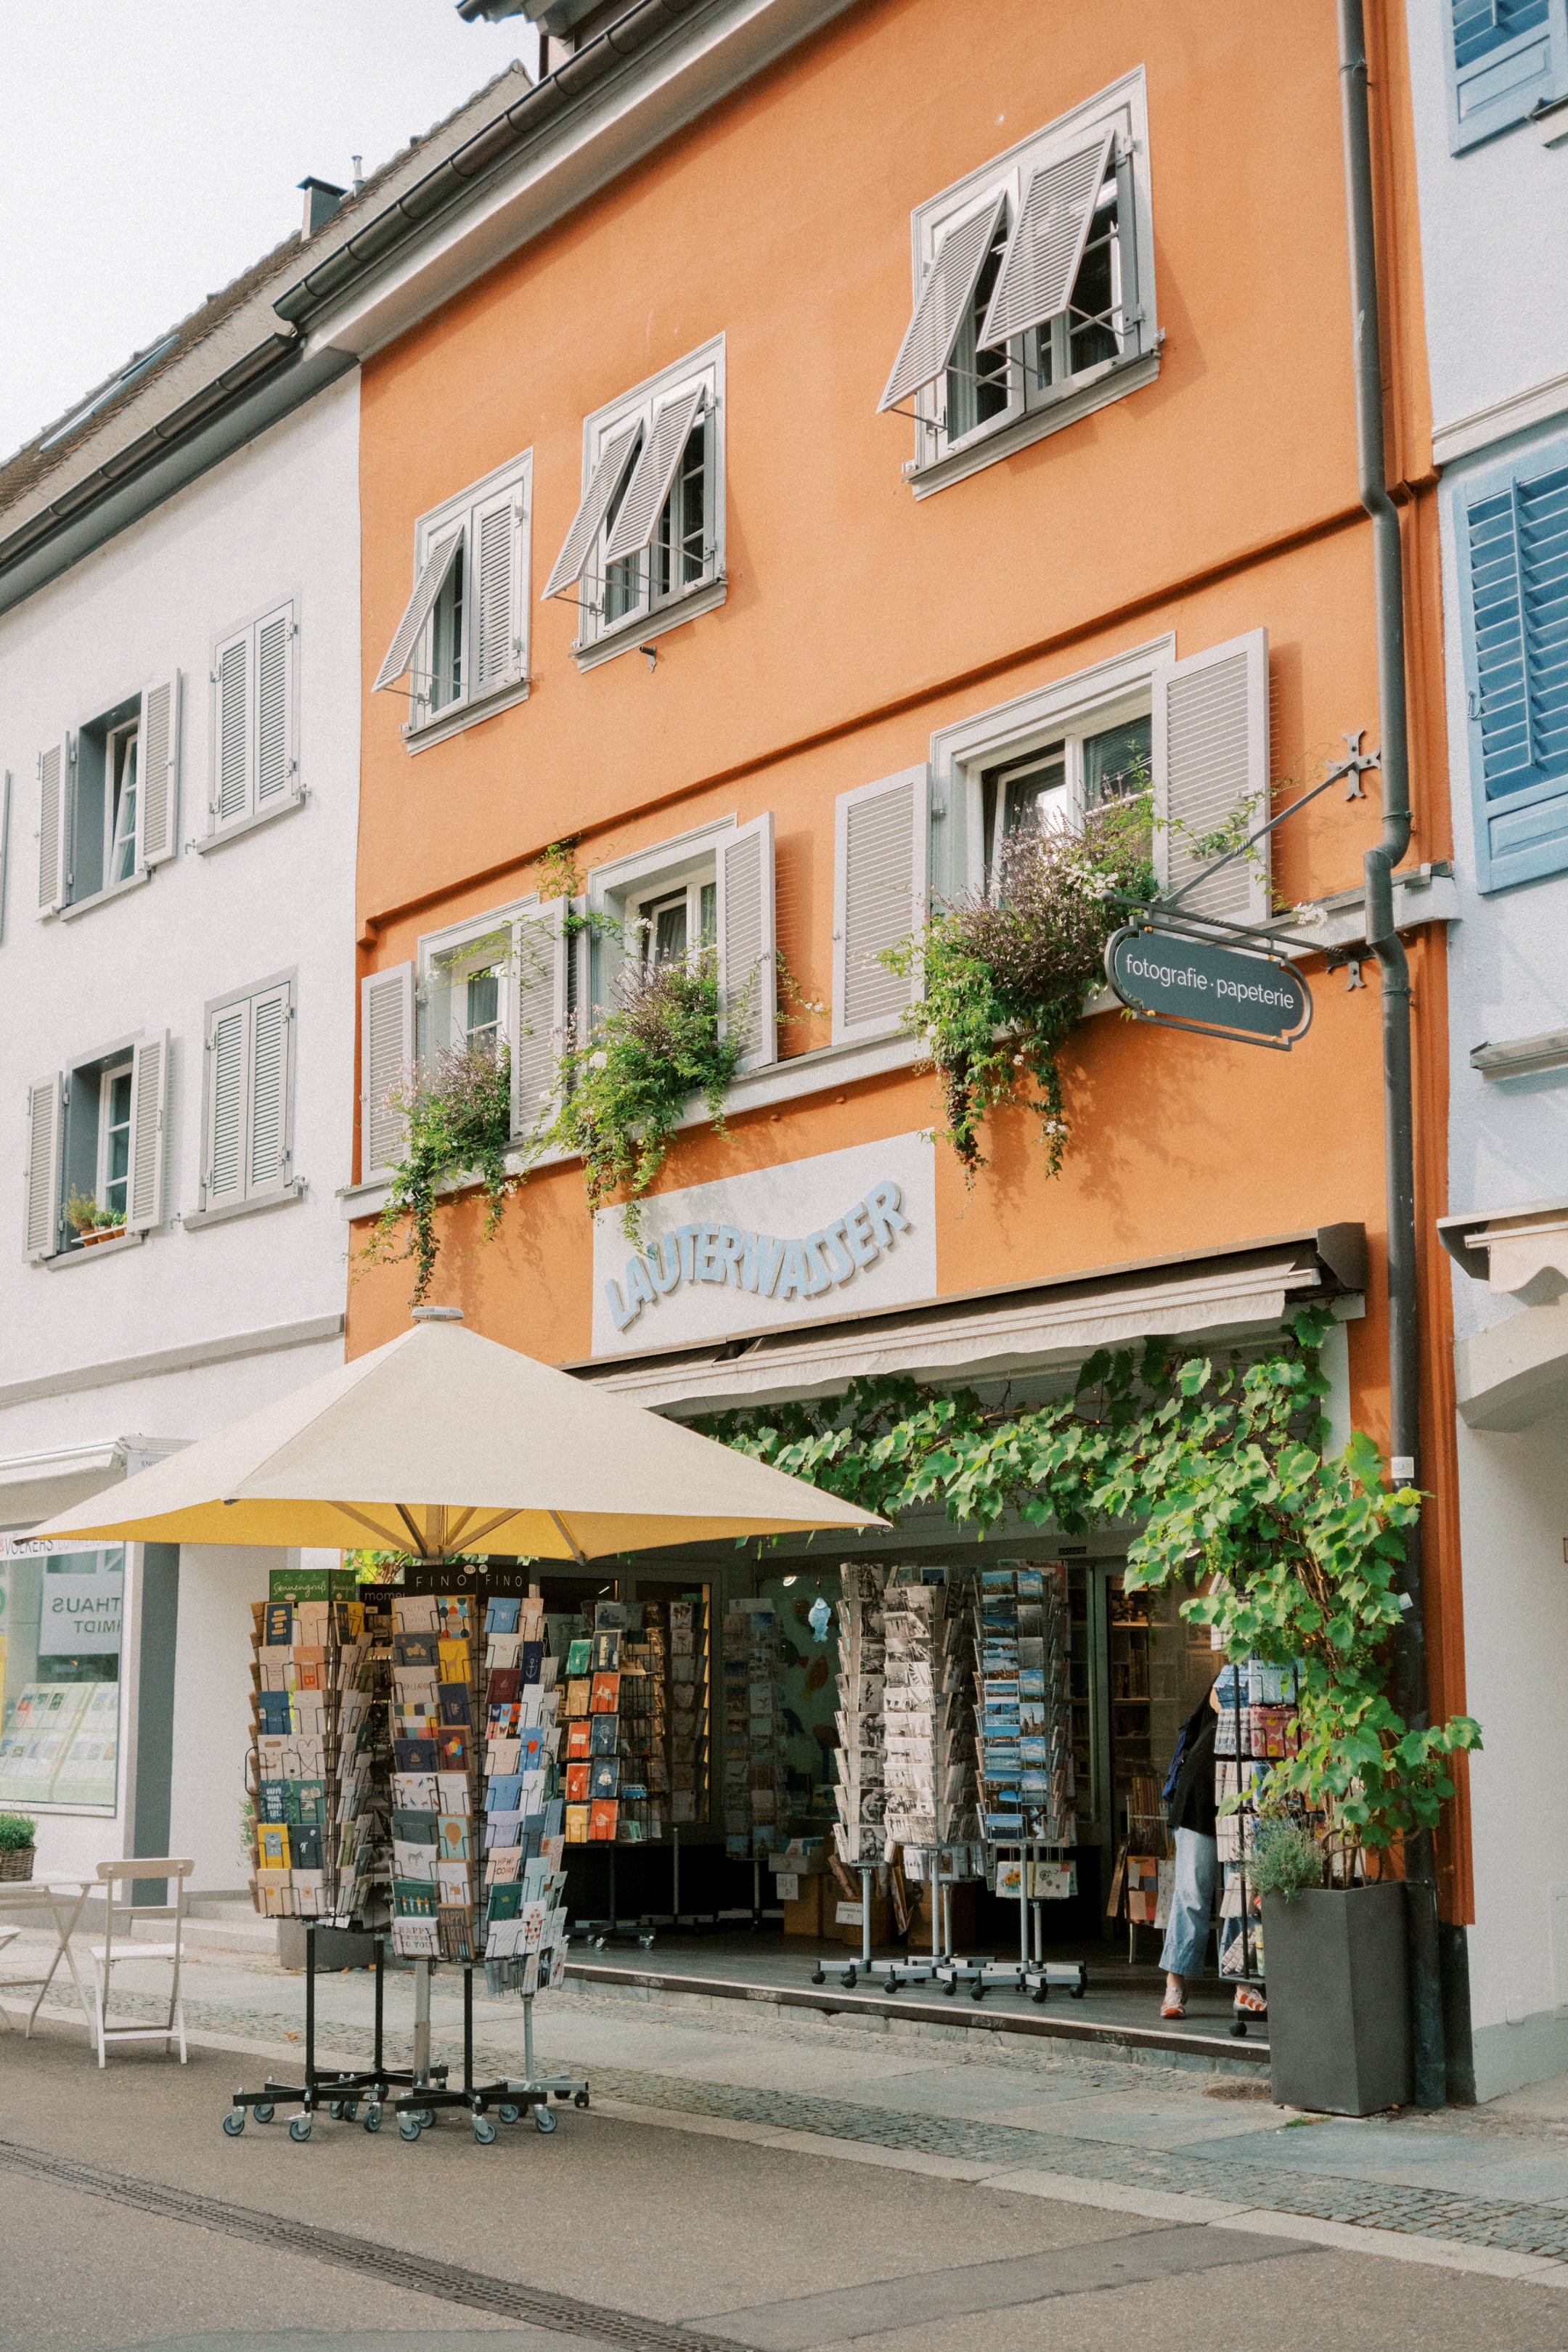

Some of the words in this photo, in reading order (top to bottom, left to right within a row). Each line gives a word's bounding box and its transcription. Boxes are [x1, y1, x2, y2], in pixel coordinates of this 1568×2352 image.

[1125, 954, 1208, 990] fotografie
[1217, 977, 1295, 1009] papeterie
[605, 1180, 912, 1331] LAUTERWASSER
[416, 1575, 467, 1588] FINO
[486, 1574, 523, 1587] FINO
